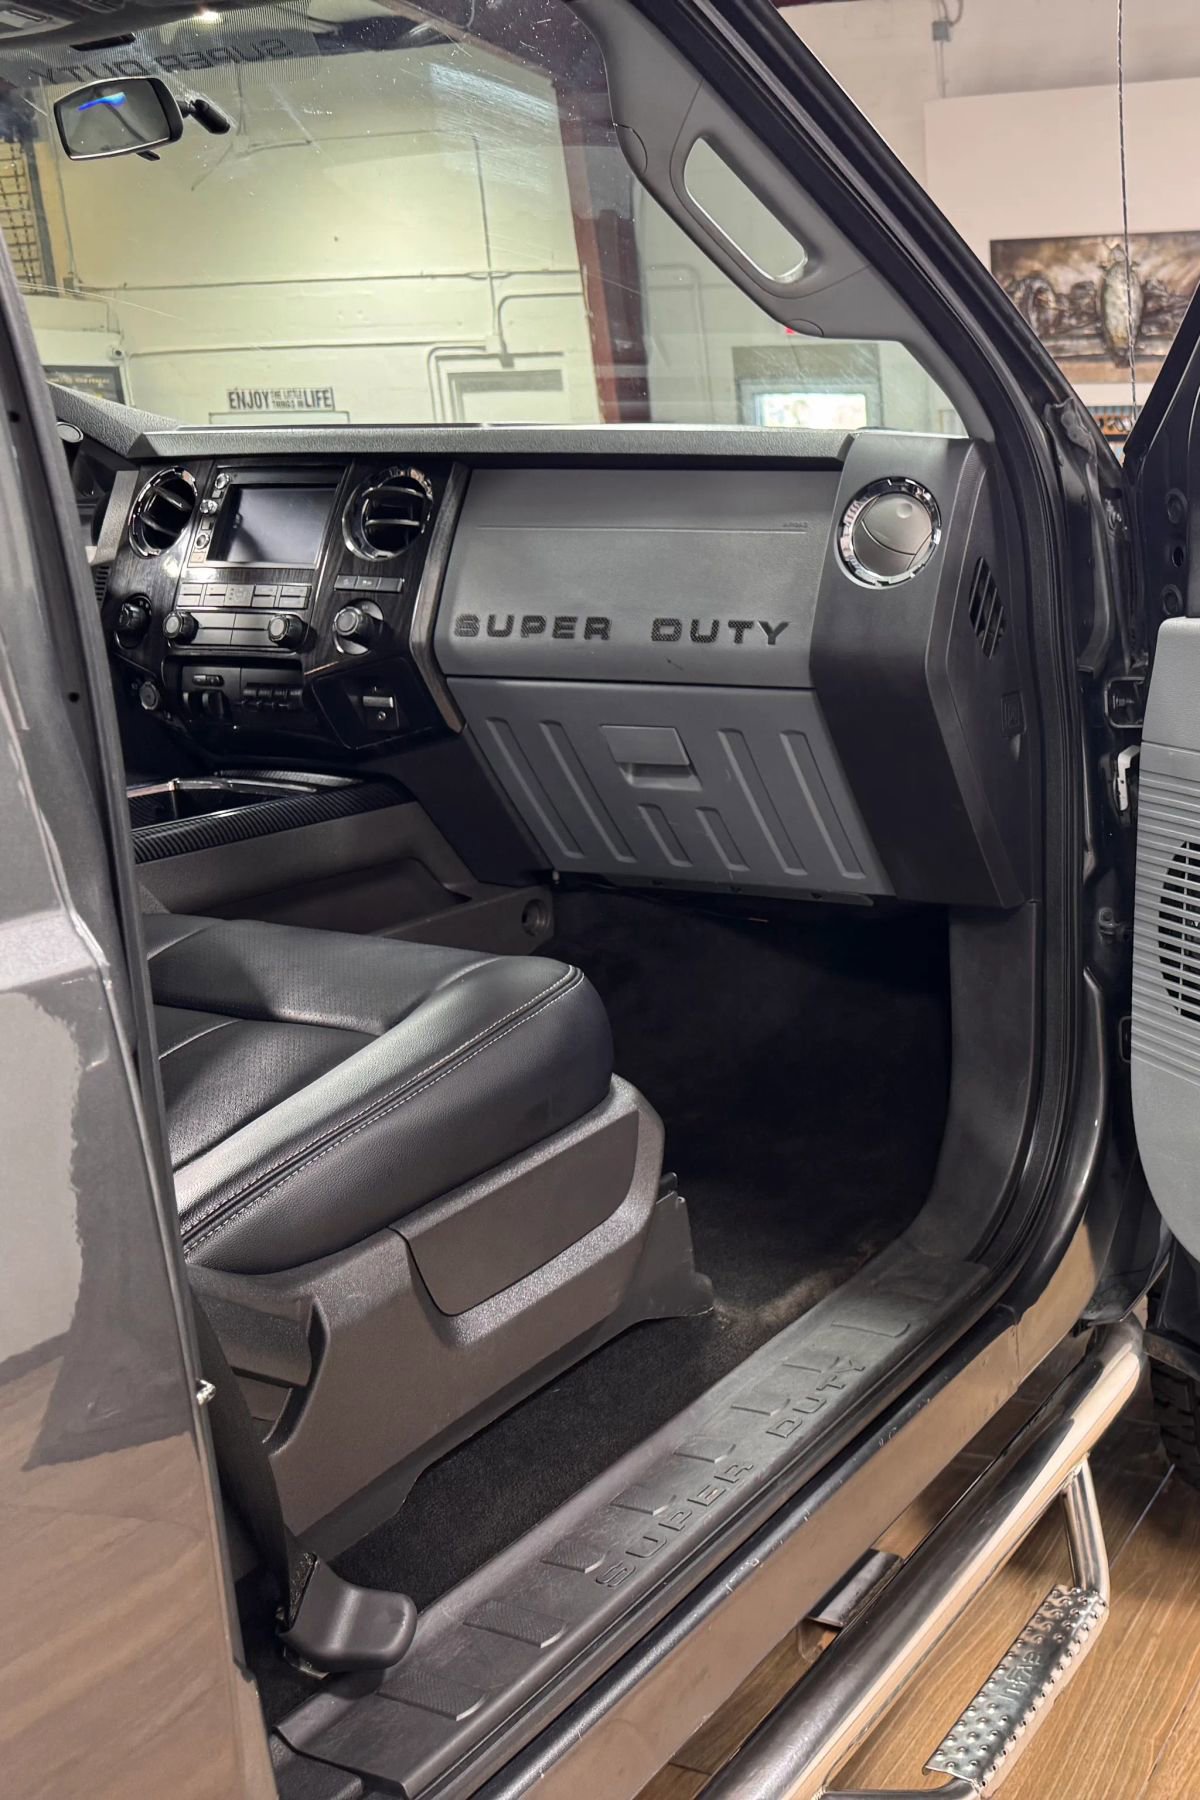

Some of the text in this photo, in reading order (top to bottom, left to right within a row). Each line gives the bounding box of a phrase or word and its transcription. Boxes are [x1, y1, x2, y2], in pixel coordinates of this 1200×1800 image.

[228, 391, 269, 409] ENJOY
[303, 389, 332, 408] LIFE
[454, 614, 790, 645] SUPER DUTY
[595, 1358, 867, 1588] SUPER DUTY
